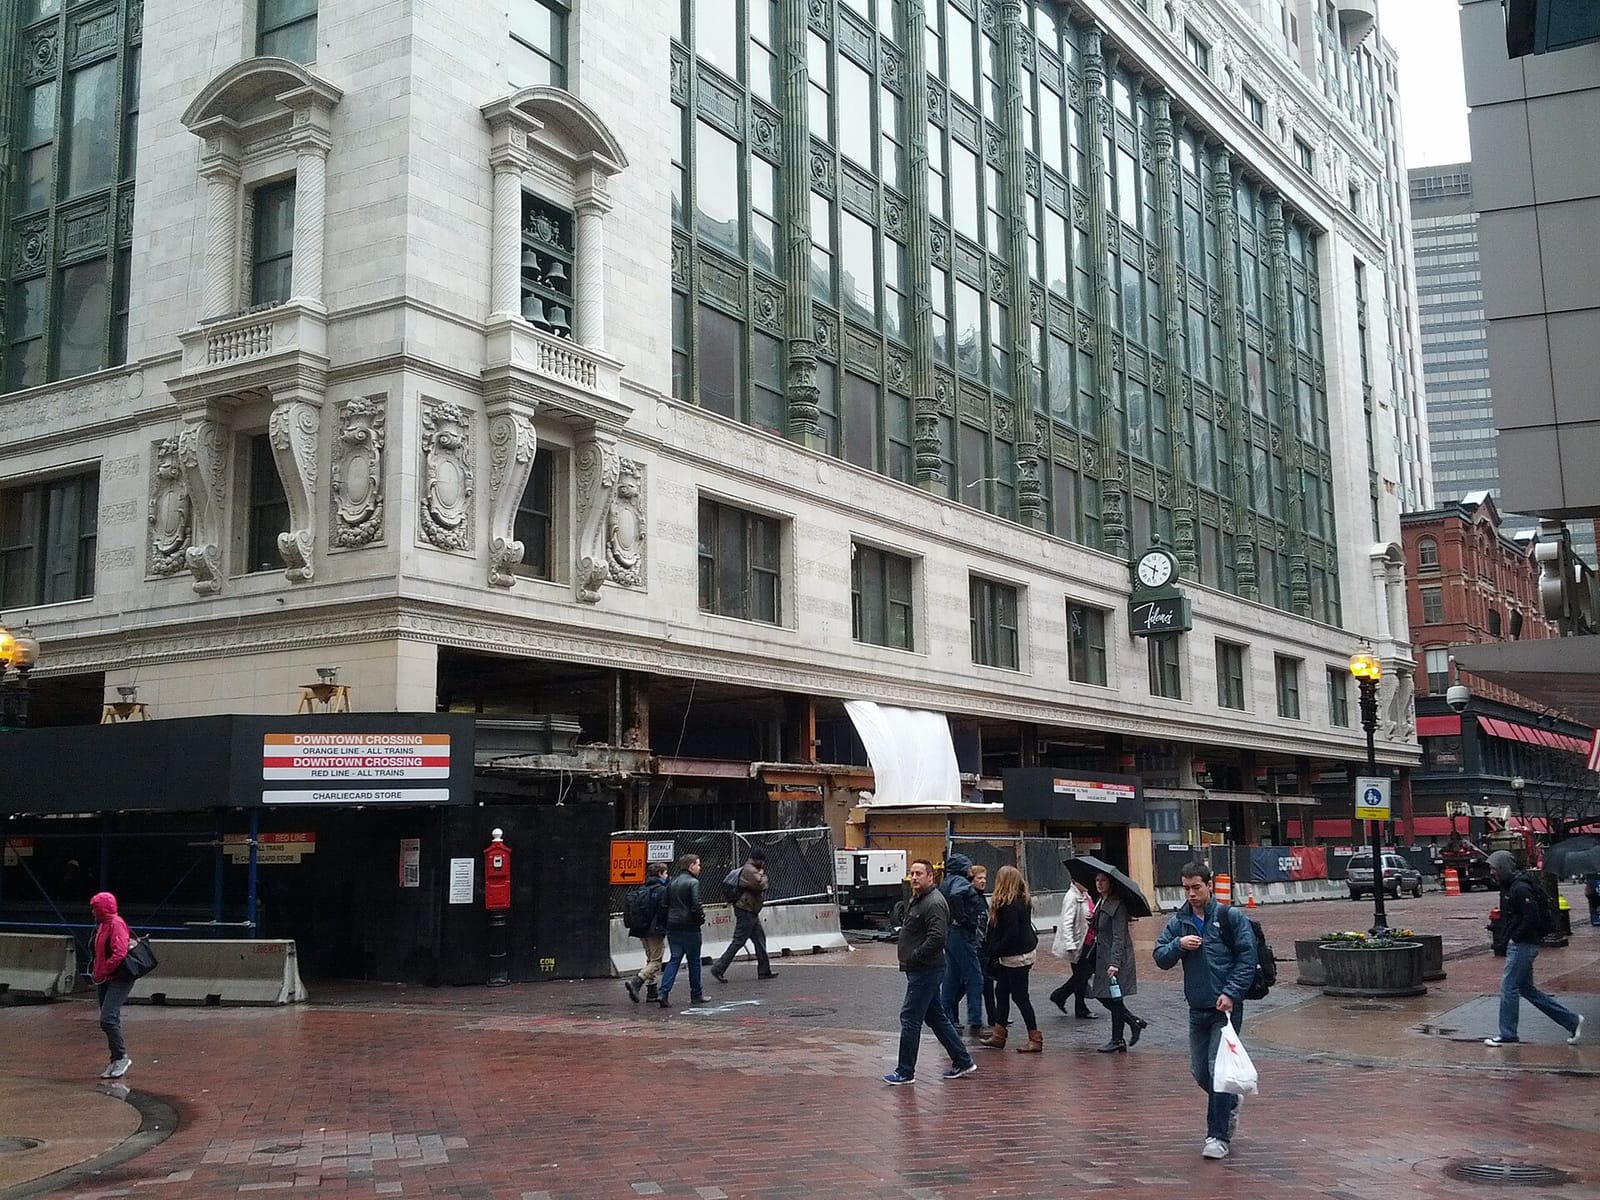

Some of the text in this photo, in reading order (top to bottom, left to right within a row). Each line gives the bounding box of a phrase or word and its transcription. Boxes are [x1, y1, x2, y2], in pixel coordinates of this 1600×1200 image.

[294, 735, 423, 745] DOWNTOWN CROSSING
[302, 747, 339, 755] ORANGE
[340, 747, 360, 755] LINE
[366, 747, 382, 755] ALL
[384, 747, 414, 755] TRAINS
[293, 757, 422, 767] DOWNTOWN CROSSING
[311, 769, 329, 777] RED
[330, 769, 350, 777] LINE
[312, 791, 402, 800] CHARLIECARD STORE
[613, 859, 643, 869] DETOUR
